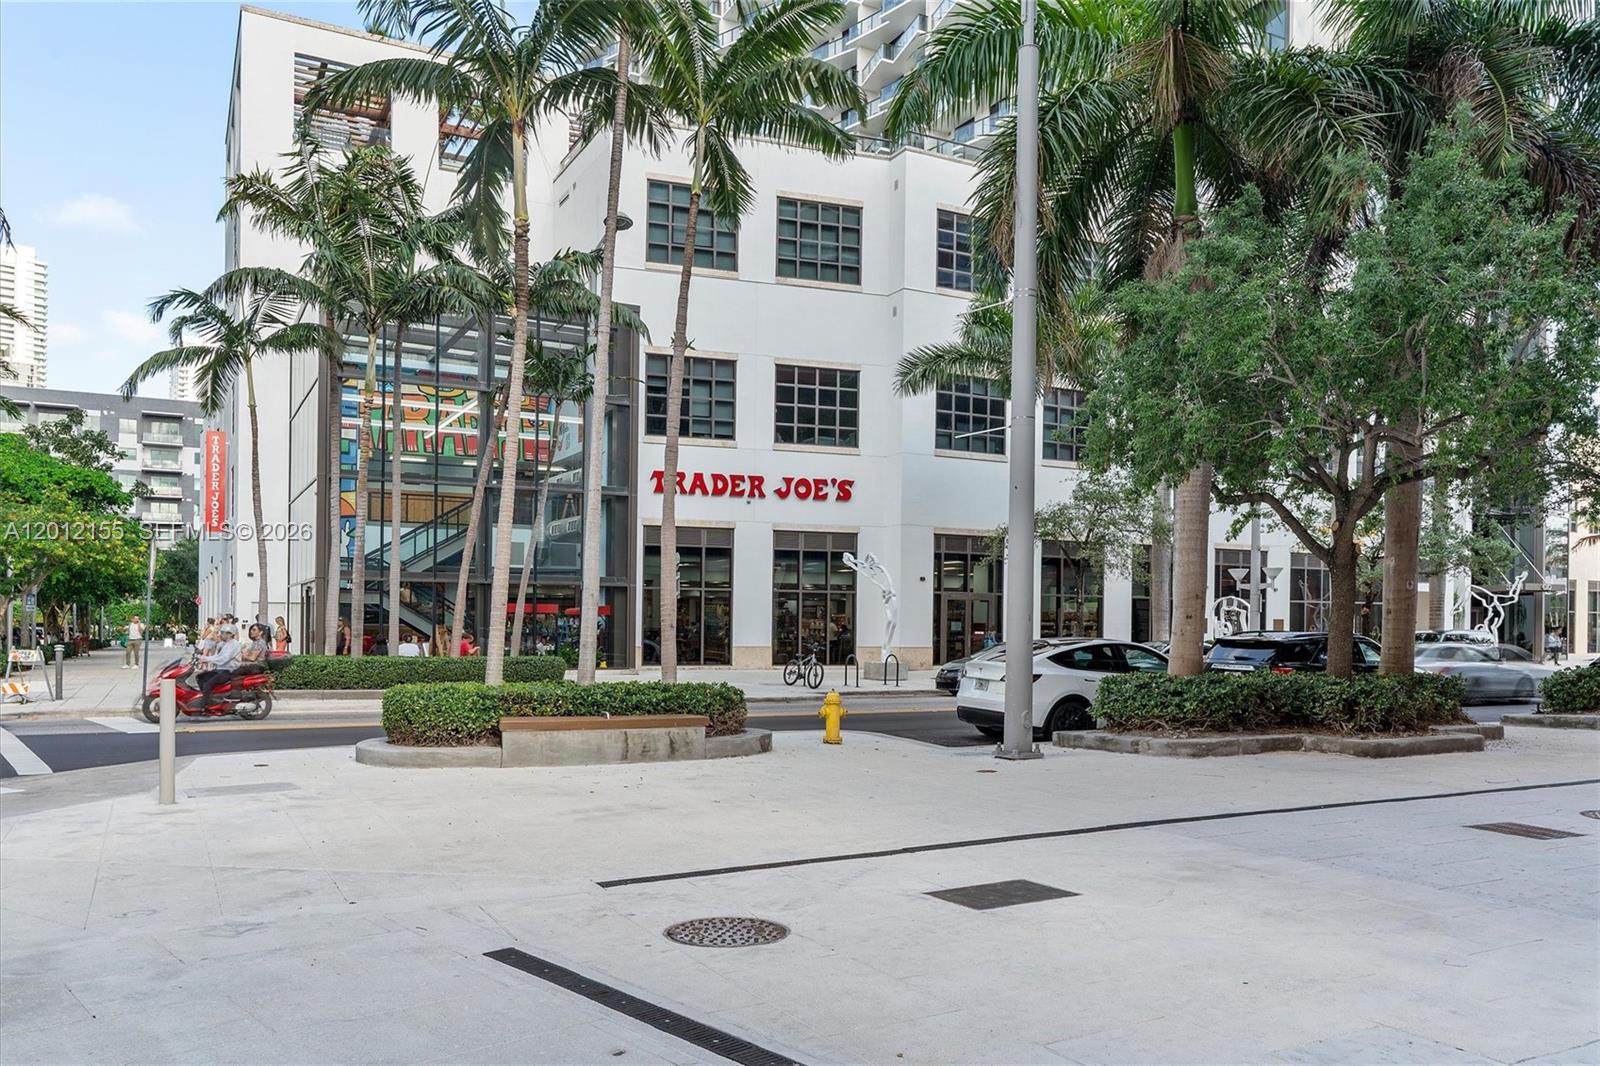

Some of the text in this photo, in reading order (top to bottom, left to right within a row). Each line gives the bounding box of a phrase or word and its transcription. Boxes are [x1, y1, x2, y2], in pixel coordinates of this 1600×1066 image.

[211, 435, 220, 528] TRADER JOES
[650, 470, 855, 502] TRADER JOE'S
